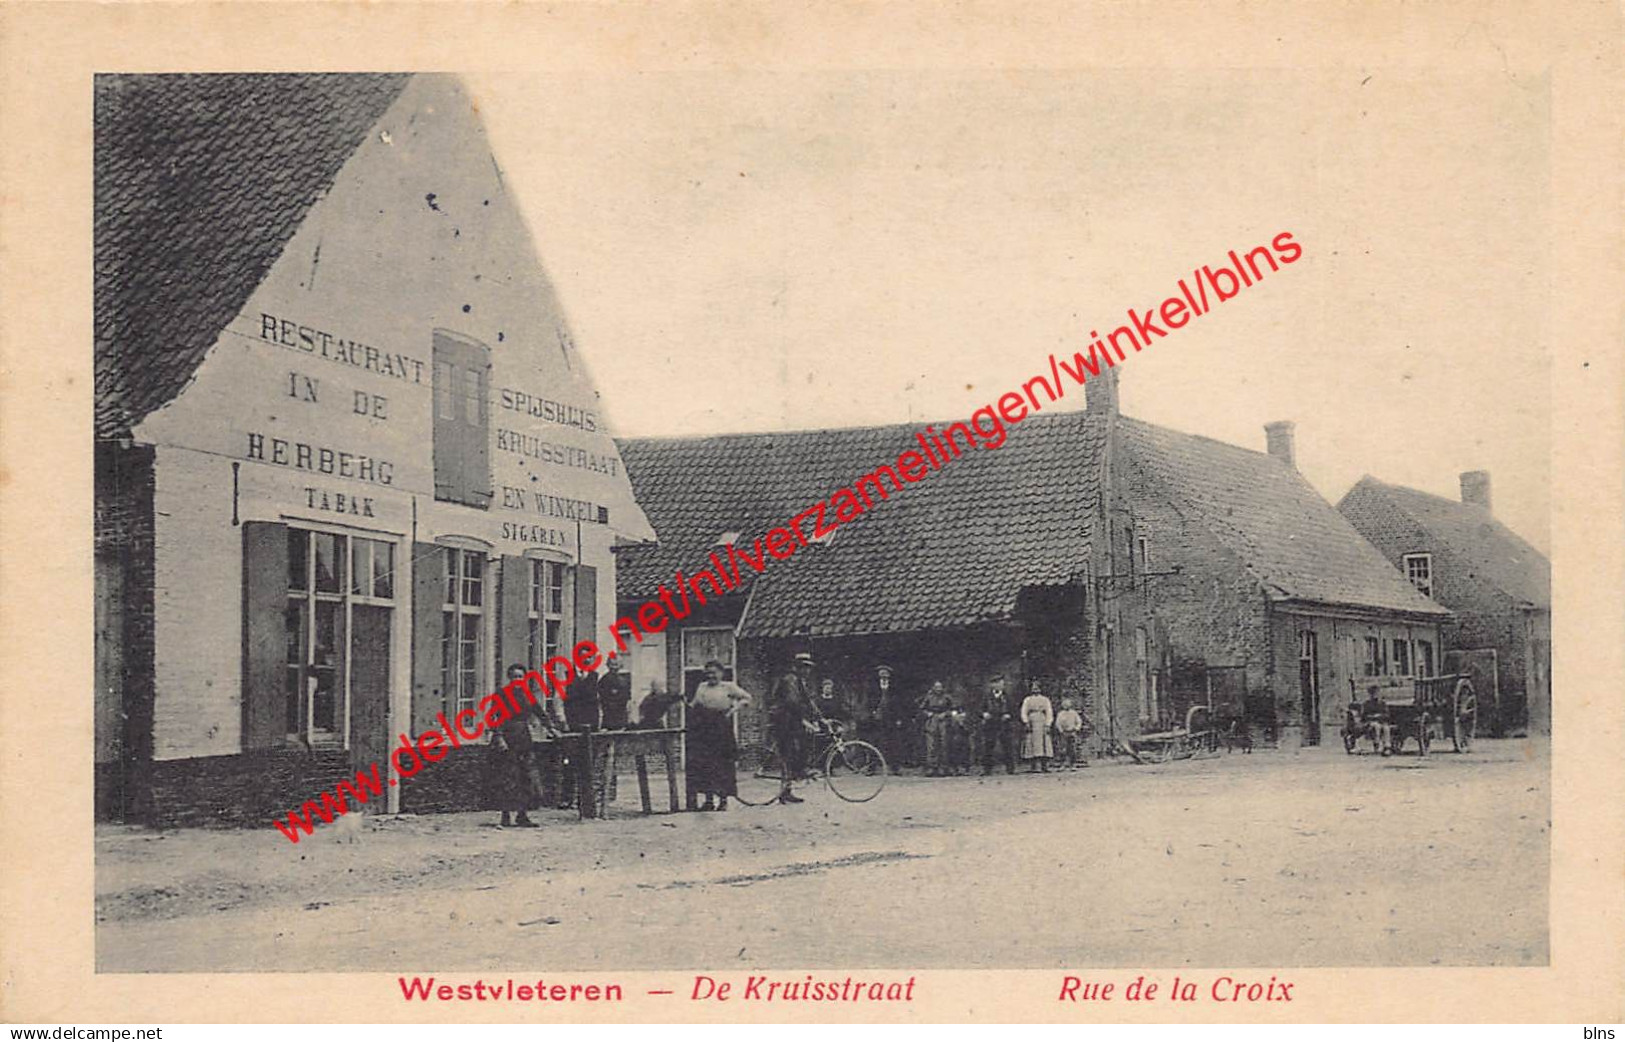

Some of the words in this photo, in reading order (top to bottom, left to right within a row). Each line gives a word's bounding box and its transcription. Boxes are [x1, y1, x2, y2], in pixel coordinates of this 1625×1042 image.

[260, 313, 424, 383] RESTAURANT
[501, 387, 598, 432] SPIJSHUIS
[288, 371, 319, 403] IN
[353, 389, 388, 420] DE
[497, 428, 619, 477] KRUISSTRAAT
[247, 432, 394, 485] HERBERG
[503, 485, 526, 510] EN
[534, 491, 599, 524] WINKEL
[304, 487, 375, 518] TABAK
[501, 521, 566, 547] SIGAREN
